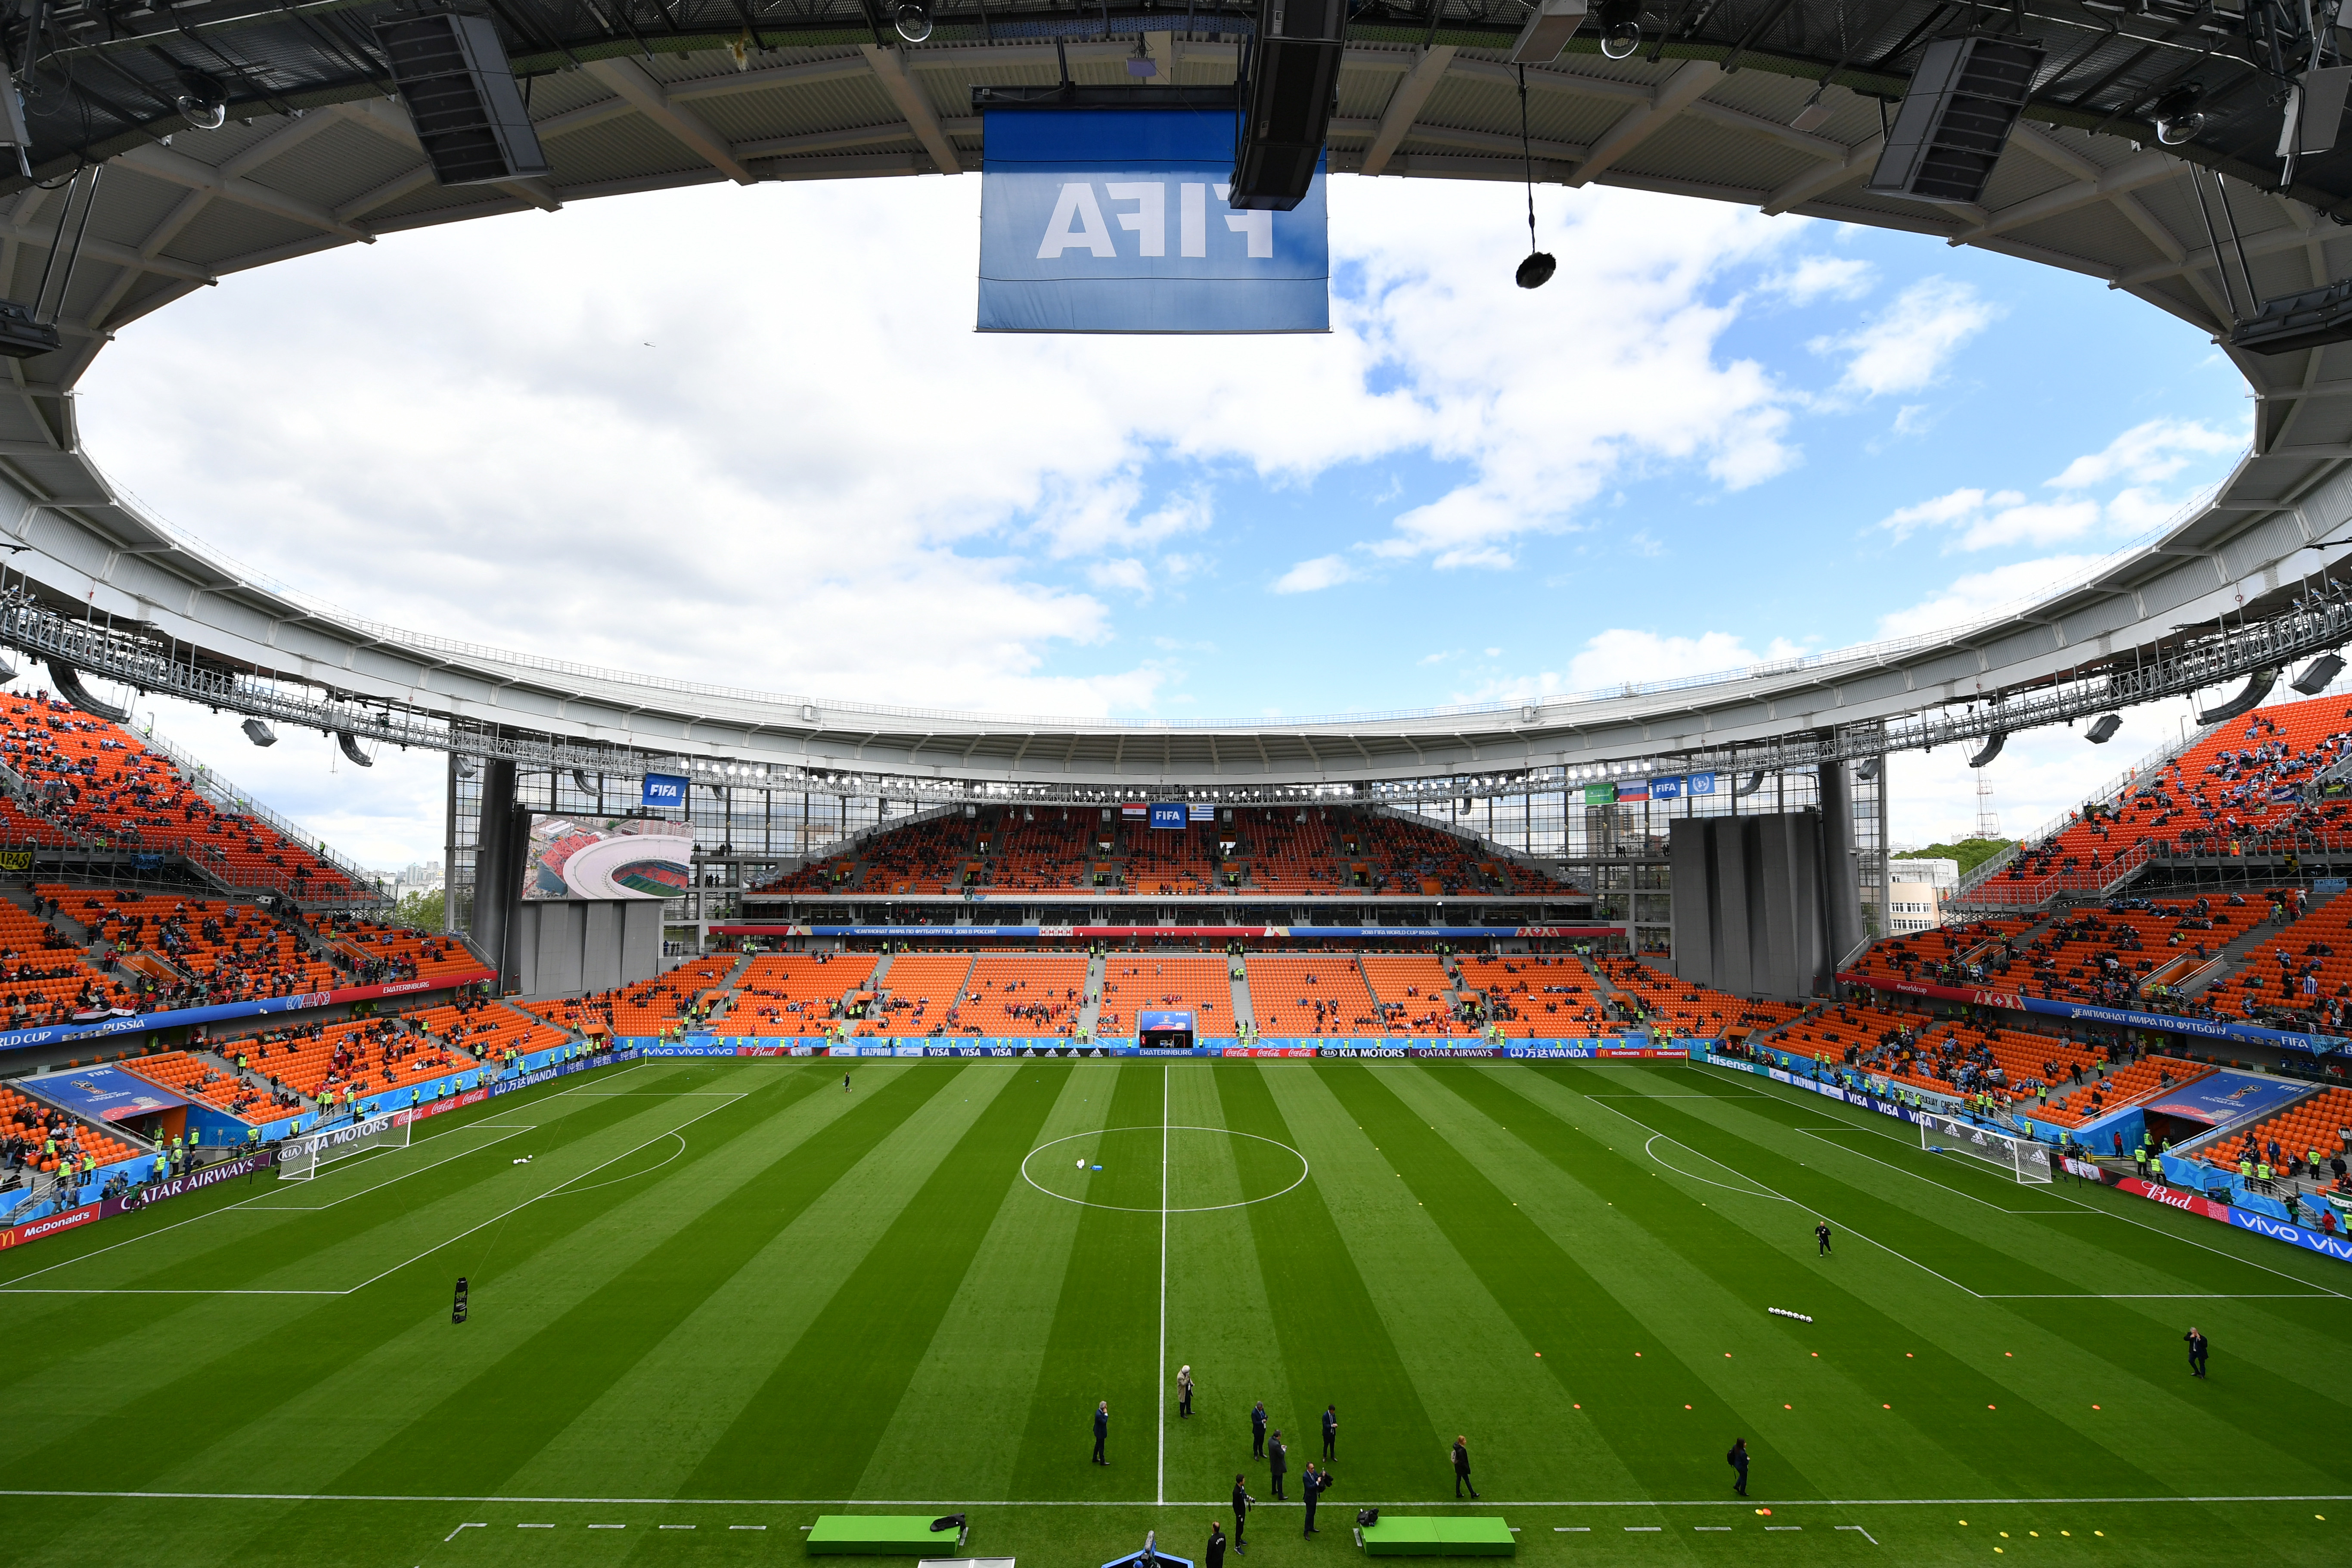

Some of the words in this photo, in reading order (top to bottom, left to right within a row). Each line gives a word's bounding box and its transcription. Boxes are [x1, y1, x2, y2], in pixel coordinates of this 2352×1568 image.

[649, 784, 677, 797] FIFA
[1656, 783, 1676, 793] FIFA
[1155, 810, 1180, 820] FIFA
[383, 981, 429, 994] EKATERINBURG
[1896, 983, 1927, 994] #worldcup
[23, 1031, 52, 1043] CUP
[103, 1019, 145, 1031] RUSSIA
[2072, 1008, 2126, 1022] ЧЕМПИОНАТ
[2129, 1015, 2157, 1026] МИРА
[2160, 1019, 2174, 1028] ПО
[2177, 1021, 2226, 1035] ФУТБОЛУ
[2281, 1036, 2309, 1048] FIFA
[750, 1047, 776, 1056] Bud
[861, 1048, 891, 1056] GAZPROM
[1340, 1049, 1357, 1057] KIA
[1360, 1049, 1405, 1057] MOTORS
[1419, 1049, 1451, 1057] QATAR
[1707, 1053, 1754, 1072] Hisense
[1793, 1075, 1816, 1091] GAZPROM
[462, 1090, 484, 1105] Coca-Cola
[1846, 1091, 1868, 1108] VISA
[2200, 1096, 2228, 1105] RUSSIA
[431, 1098, 456, 1115] Coca-Cola
[1875, 1100, 1899, 1118] VISA
[1907, 1110, 1932, 1128] VISA
[304, 1136, 329, 1155] KIA
[333, 1118, 389, 1144] MOTORS
[1944, 1129, 1960, 1137] adidas
[1971, 1137, 1987, 1146] adidas
[282, 1148, 298, 1159] KIA
[2029, 1156, 2050, 1166] adidas
[121, 1180, 183, 1210] QATAR
[186, 1158, 255, 1190] AIRWAYS
[2141, 1181, 2192, 1210] Bud
[24, 1211, 90, 1237] McDonald's
[2238, 1214, 2299, 1242] vivo
